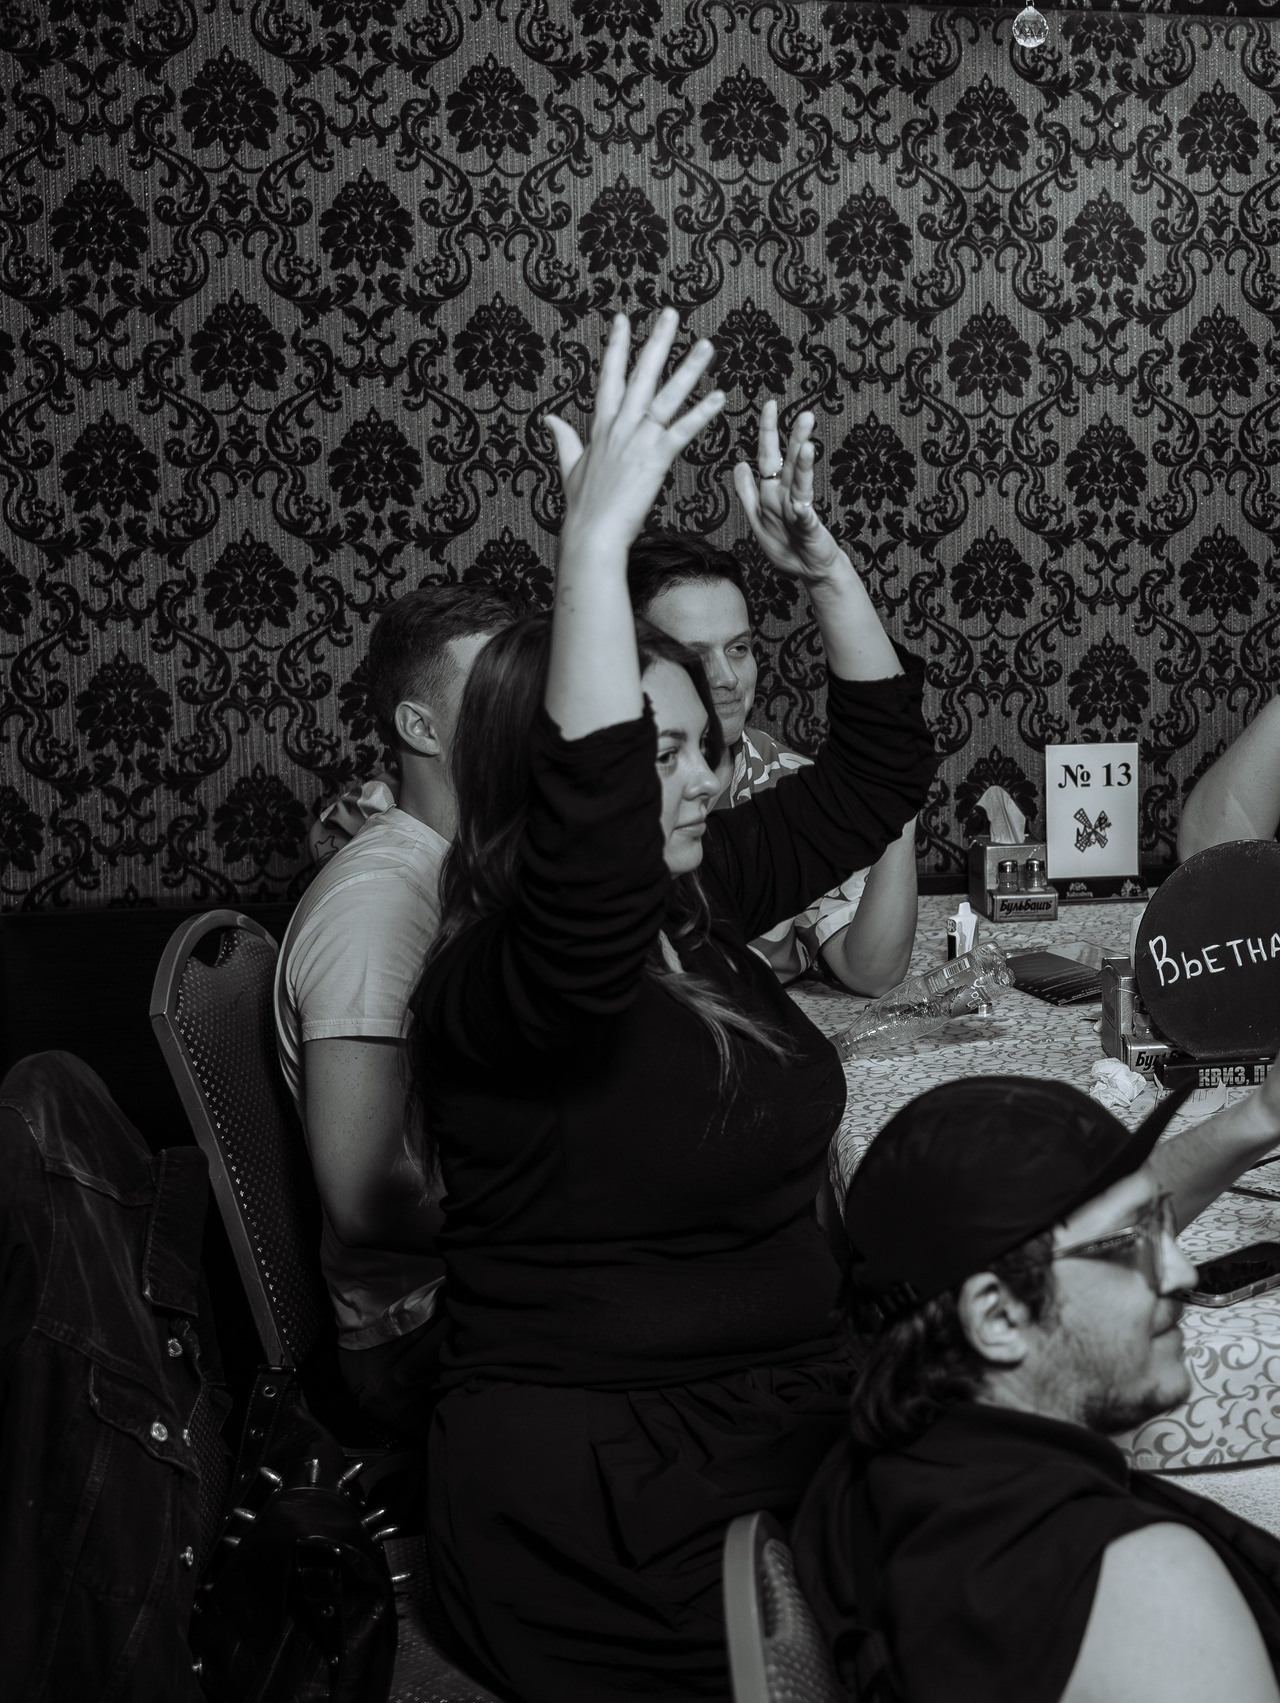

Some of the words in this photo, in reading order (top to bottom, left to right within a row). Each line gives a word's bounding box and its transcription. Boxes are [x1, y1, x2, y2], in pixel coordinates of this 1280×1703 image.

[1058, 764, 1091, 788] №
[1102, 762, 1132, 787] 13
[1198, 1065, 1250, 1087] КВИЗ,
